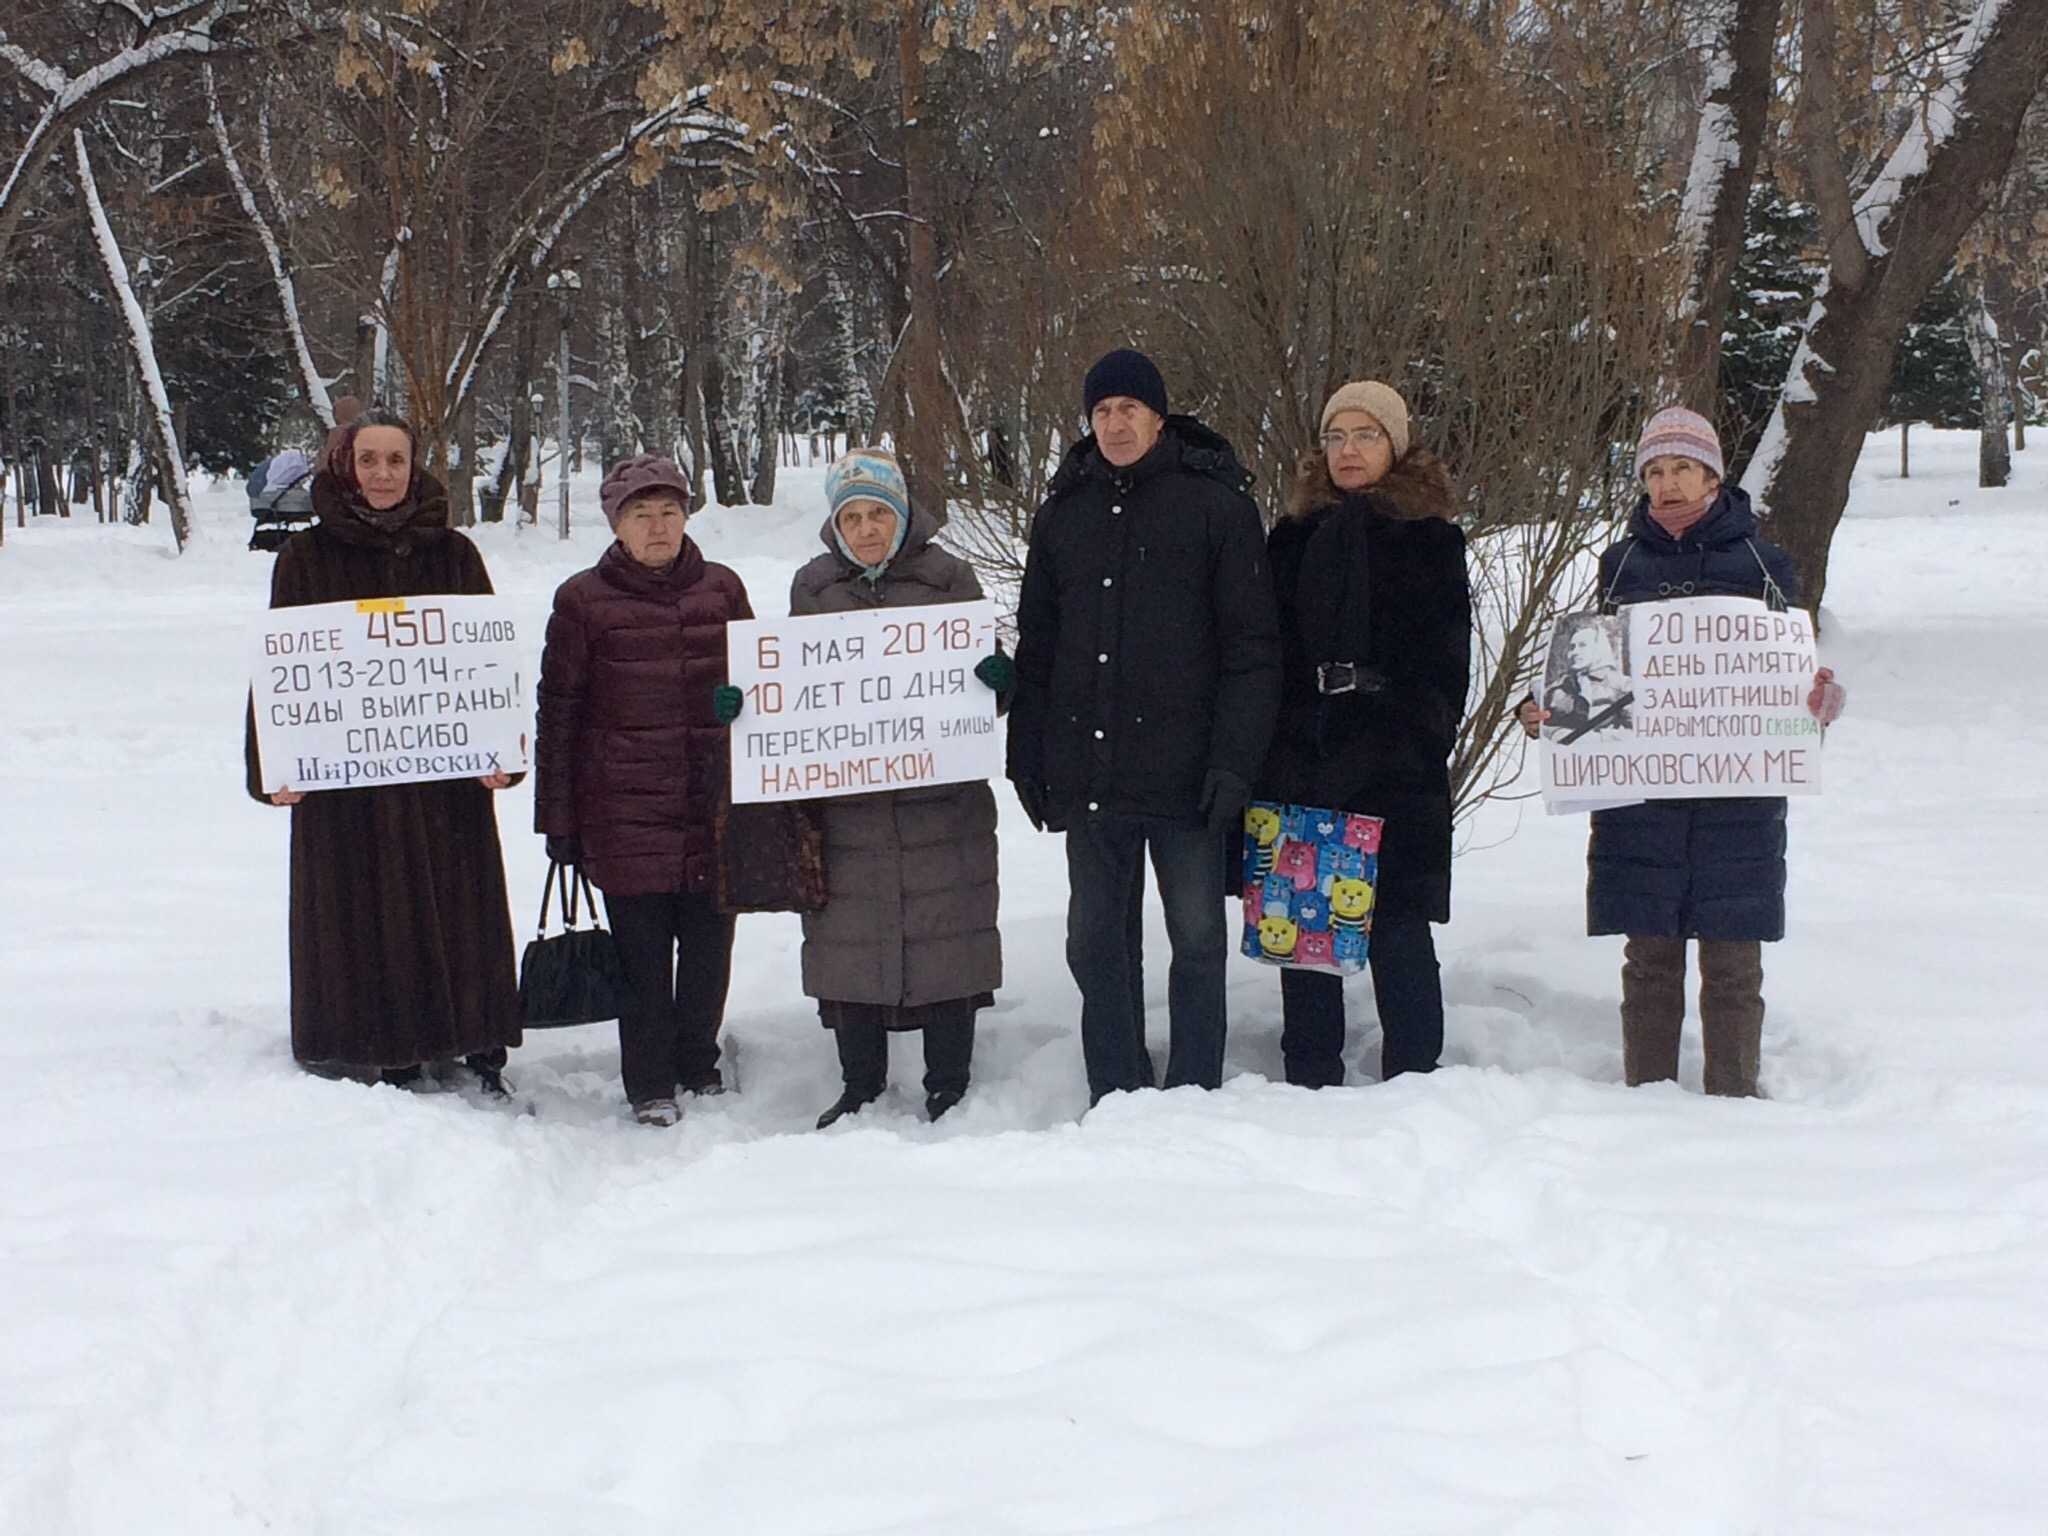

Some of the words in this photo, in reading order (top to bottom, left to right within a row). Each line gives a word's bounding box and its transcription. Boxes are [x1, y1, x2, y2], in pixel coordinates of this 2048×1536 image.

[265, 628, 344, 655] БОЛЕЕ
[367, 608, 446, 648] 450
[452, 620, 516, 644] СУДОВ
[1648, 612, 1684, 645] 20
[758, 636, 780, 669] 6
[802, 636, 864, 667] МАЯ
[1642, 653, 1706, 679] ДЕНЬ
[1714, 651, 1814, 675] ПАМЯТИ
[746, 682, 783, 715] 10
[793, 681, 845, 711] ЛЕТ
[860, 676, 891, 703] СО
[903, 668, 965, 699] ДНЯ
[1643, 684, 1800, 711] ЗАЩИТНИЦЫ
[271, 699, 343, 727] СУДЫ
[1635, 714, 1762, 738] НАРЫМСКОГО
[1766, 717, 1819, 736] СКВЕРА
[346, 722, 469, 754] СПАСИБО
[747, 716, 925, 758] ПЕРЕКРЫТИЯ
[761, 748, 935, 795] НАРЫМСКОЙ
[1551, 751, 1755, 788] ШИРОКОВСКИХ
